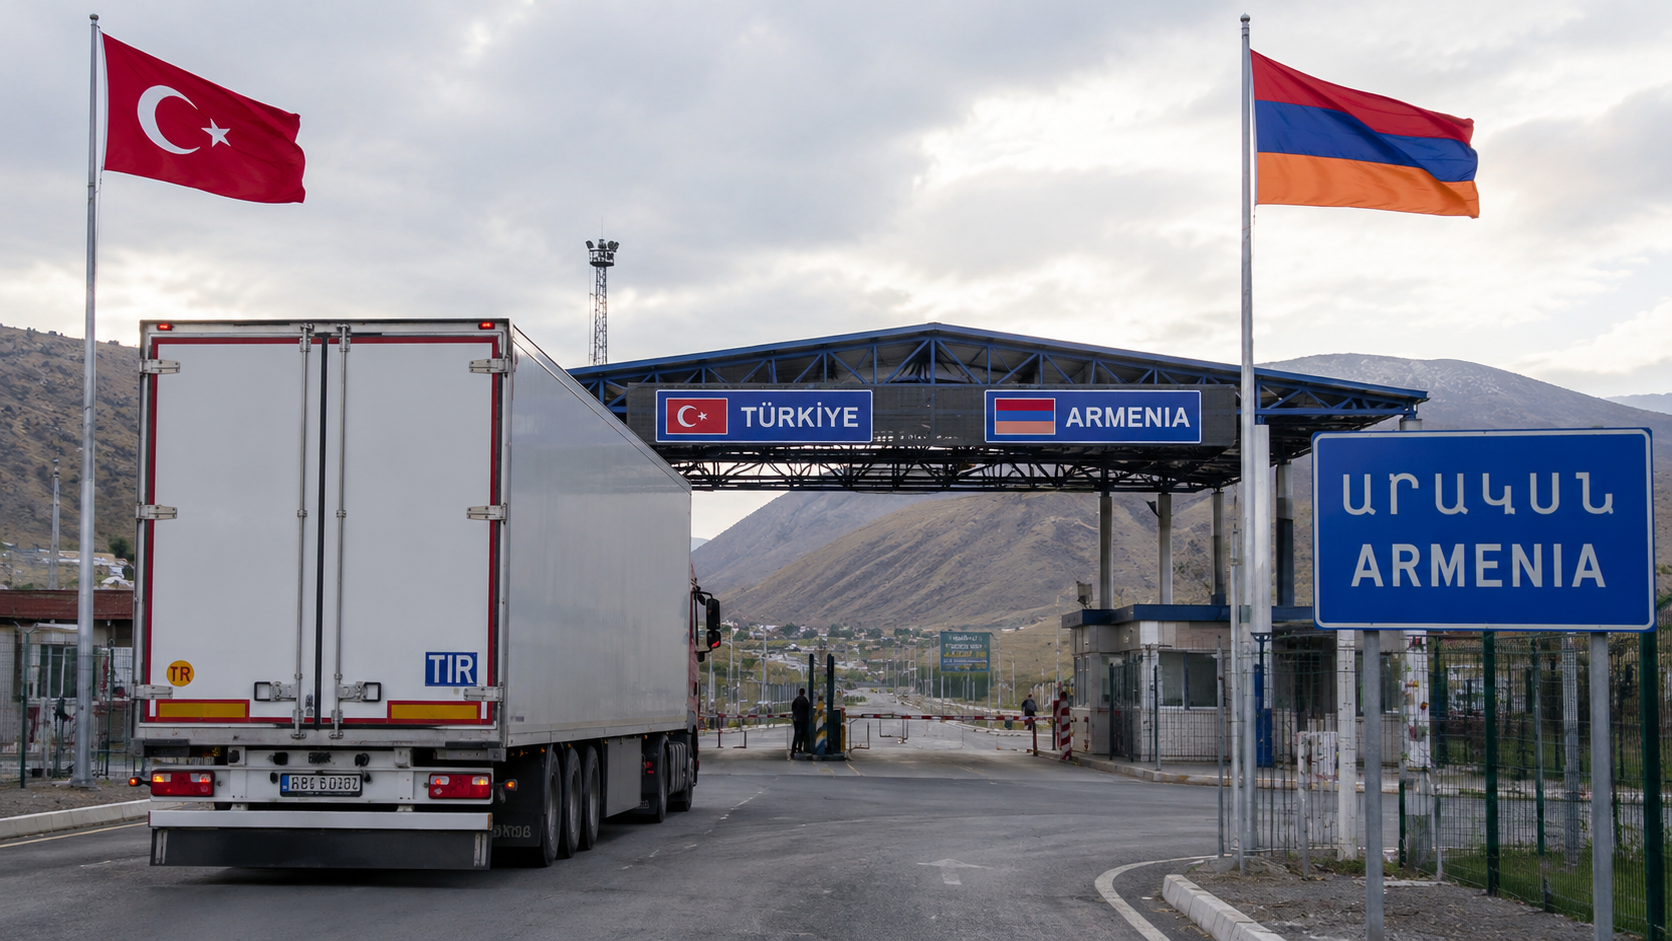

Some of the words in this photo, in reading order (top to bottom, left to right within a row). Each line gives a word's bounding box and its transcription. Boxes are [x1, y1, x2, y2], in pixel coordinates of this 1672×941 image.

[740, 401, 859, 428] TÜRKİYE
[1065, 406, 1191, 428] ARMENIA
[1351, 543, 1606, 588] ARMENIA
[170, 666, 191, 683] TR
[428, 654, 475, 684] TIR
